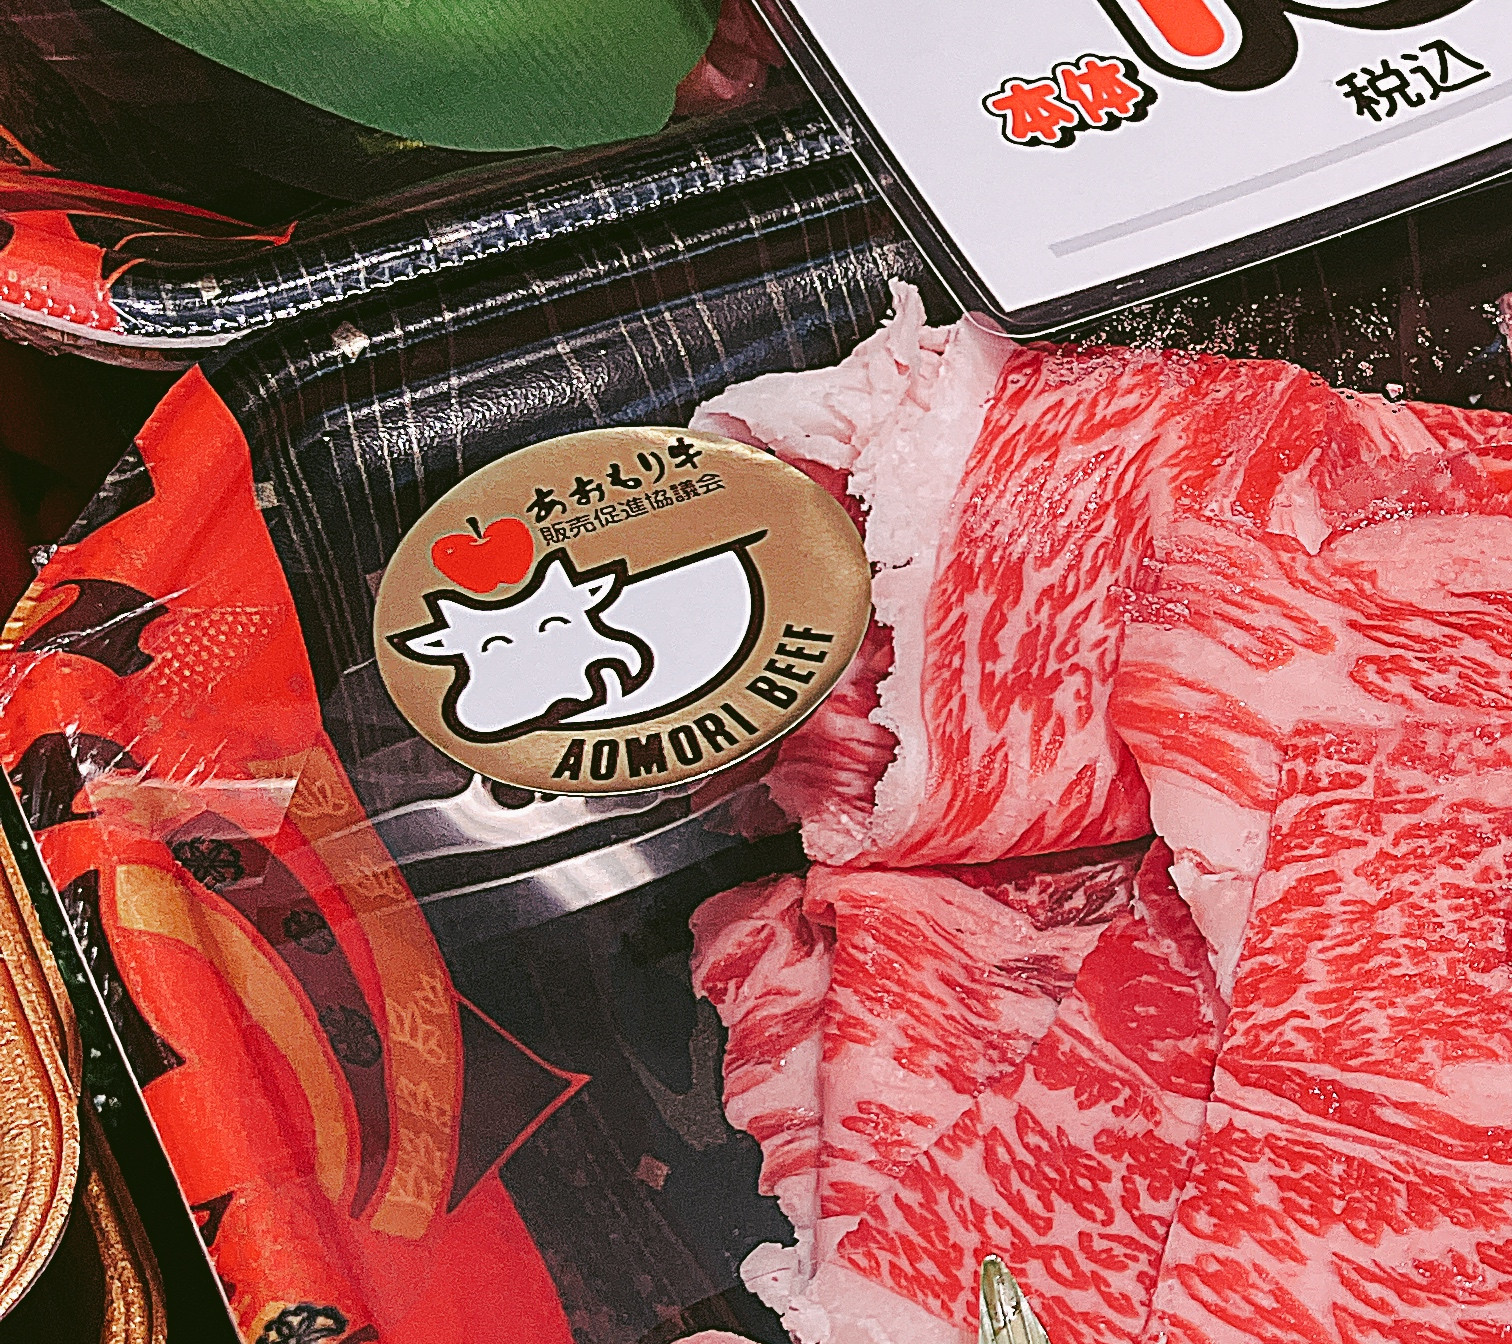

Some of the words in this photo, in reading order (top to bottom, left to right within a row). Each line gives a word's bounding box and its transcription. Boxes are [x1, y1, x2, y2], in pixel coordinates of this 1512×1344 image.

[982, 54, 1157, 147] 本体
[1335, 39, 1491, 122] 税込
[539, 473, 726, 546] 販売促進協議会
[552, 702, 758, 781] AOMORI
[746, 622, 839, 710] BEEF
